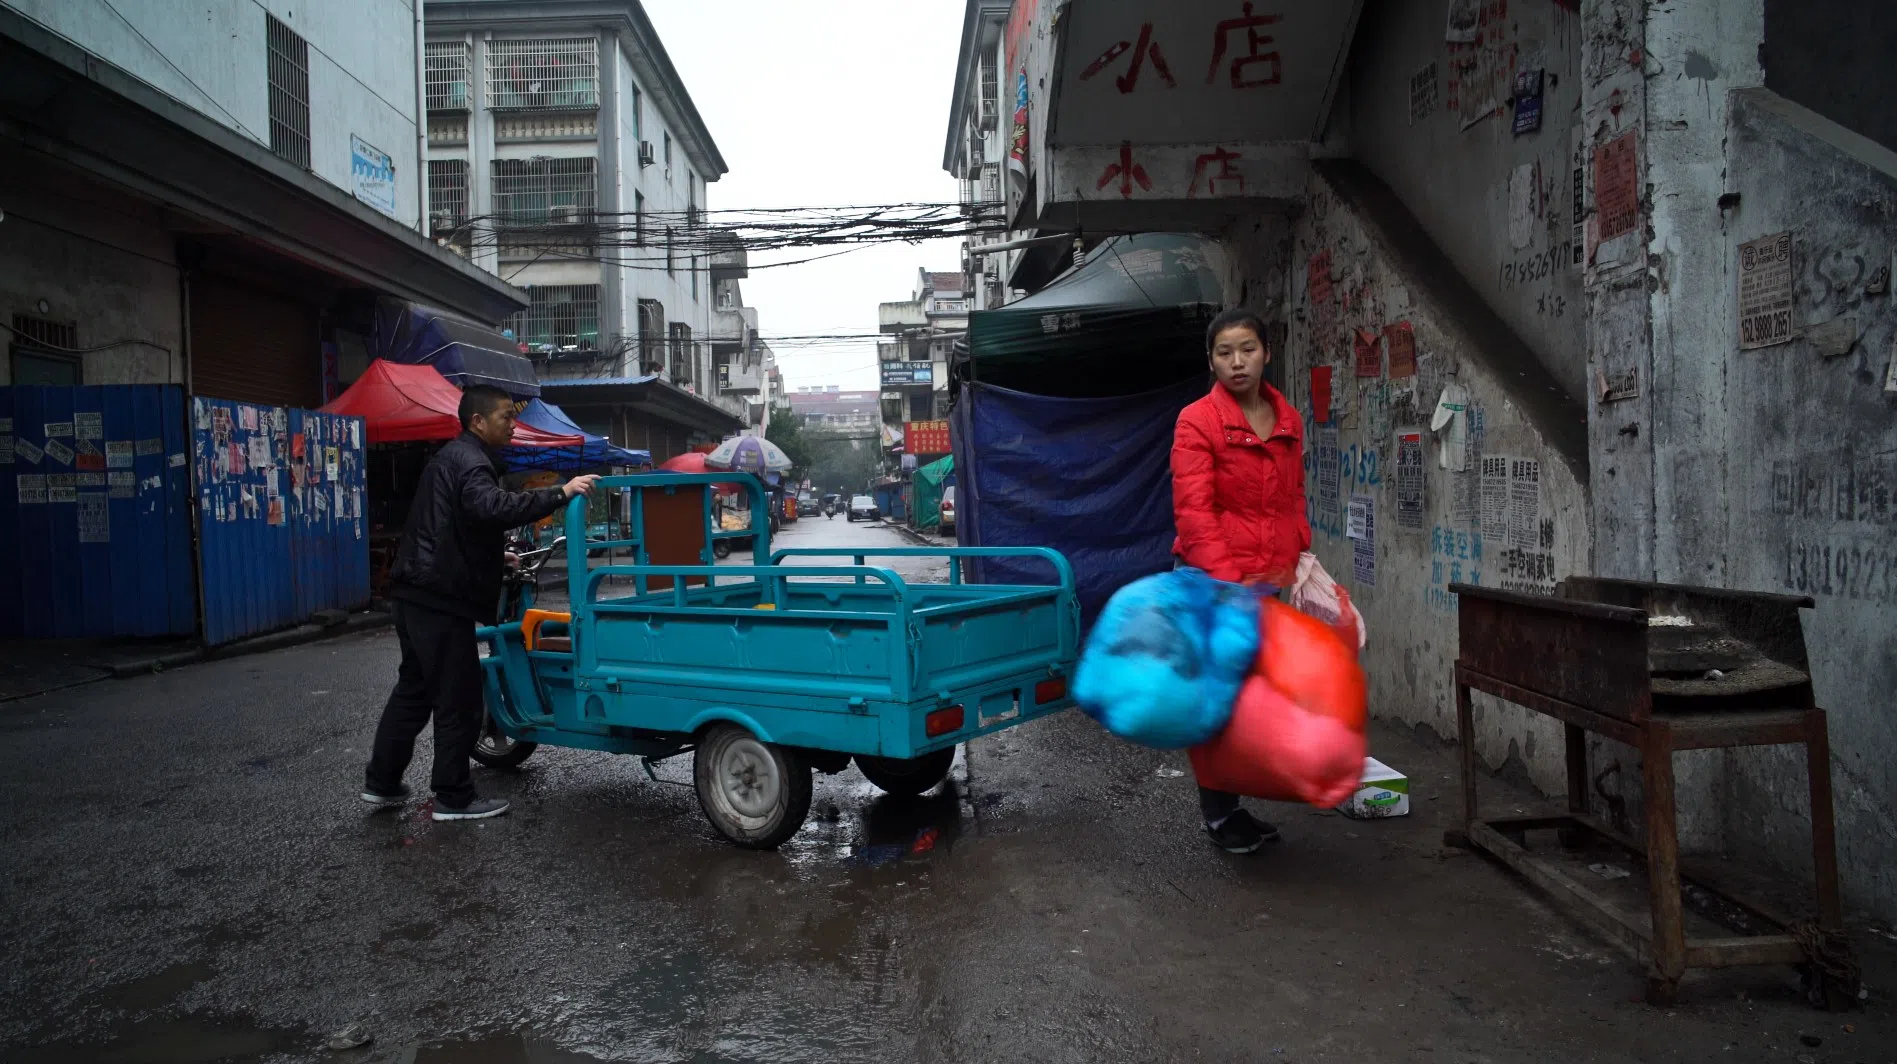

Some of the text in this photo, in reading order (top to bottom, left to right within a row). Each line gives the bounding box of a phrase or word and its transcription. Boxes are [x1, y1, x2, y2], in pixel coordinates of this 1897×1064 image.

[1079, 1, 1284, 94] 小店
[1096, 141, 1245, 199] 小店
[1774, 309, 1792, 338] 2651
[911, 421, 949, 432] 重庆特色
[1483, 457, 1507, 477] 牌具用品
[1512, 460, 1539, 482] 牌具用品
[1500, 545, 1556, 582] 二手空调家电
